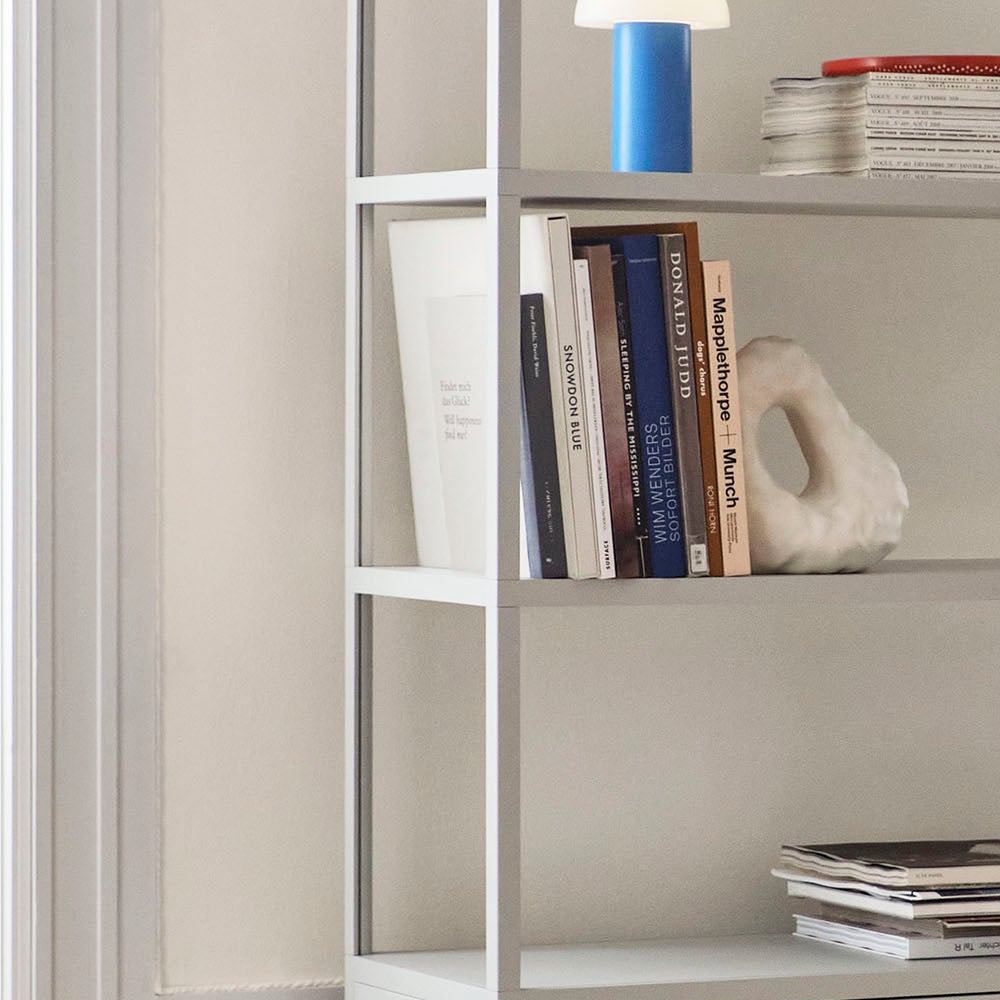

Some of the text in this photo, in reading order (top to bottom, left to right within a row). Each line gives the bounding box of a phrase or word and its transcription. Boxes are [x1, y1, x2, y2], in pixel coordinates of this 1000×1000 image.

[670, 253, 691, 399] DONALD JUDD
[620, 338, 631, 390] SLEEPING
[699, 367, 707, 397] chorus
[563, 345, 582, 450] SNOWDON BLUE
[624, 393, 633, 407] BY
[626, 410, 635, 433] THE
[711, 297, 733, 422] Mapplethorpe
[723, 448, 739, 509] Munch
[628, 435, 640, 497] MISSISSIPPI
[644, 423, 668, 544] WIM WENDERS
[659, 415, 680, 542] SOFORT BILDER
[603, 540, 611, 570] SURFACE
